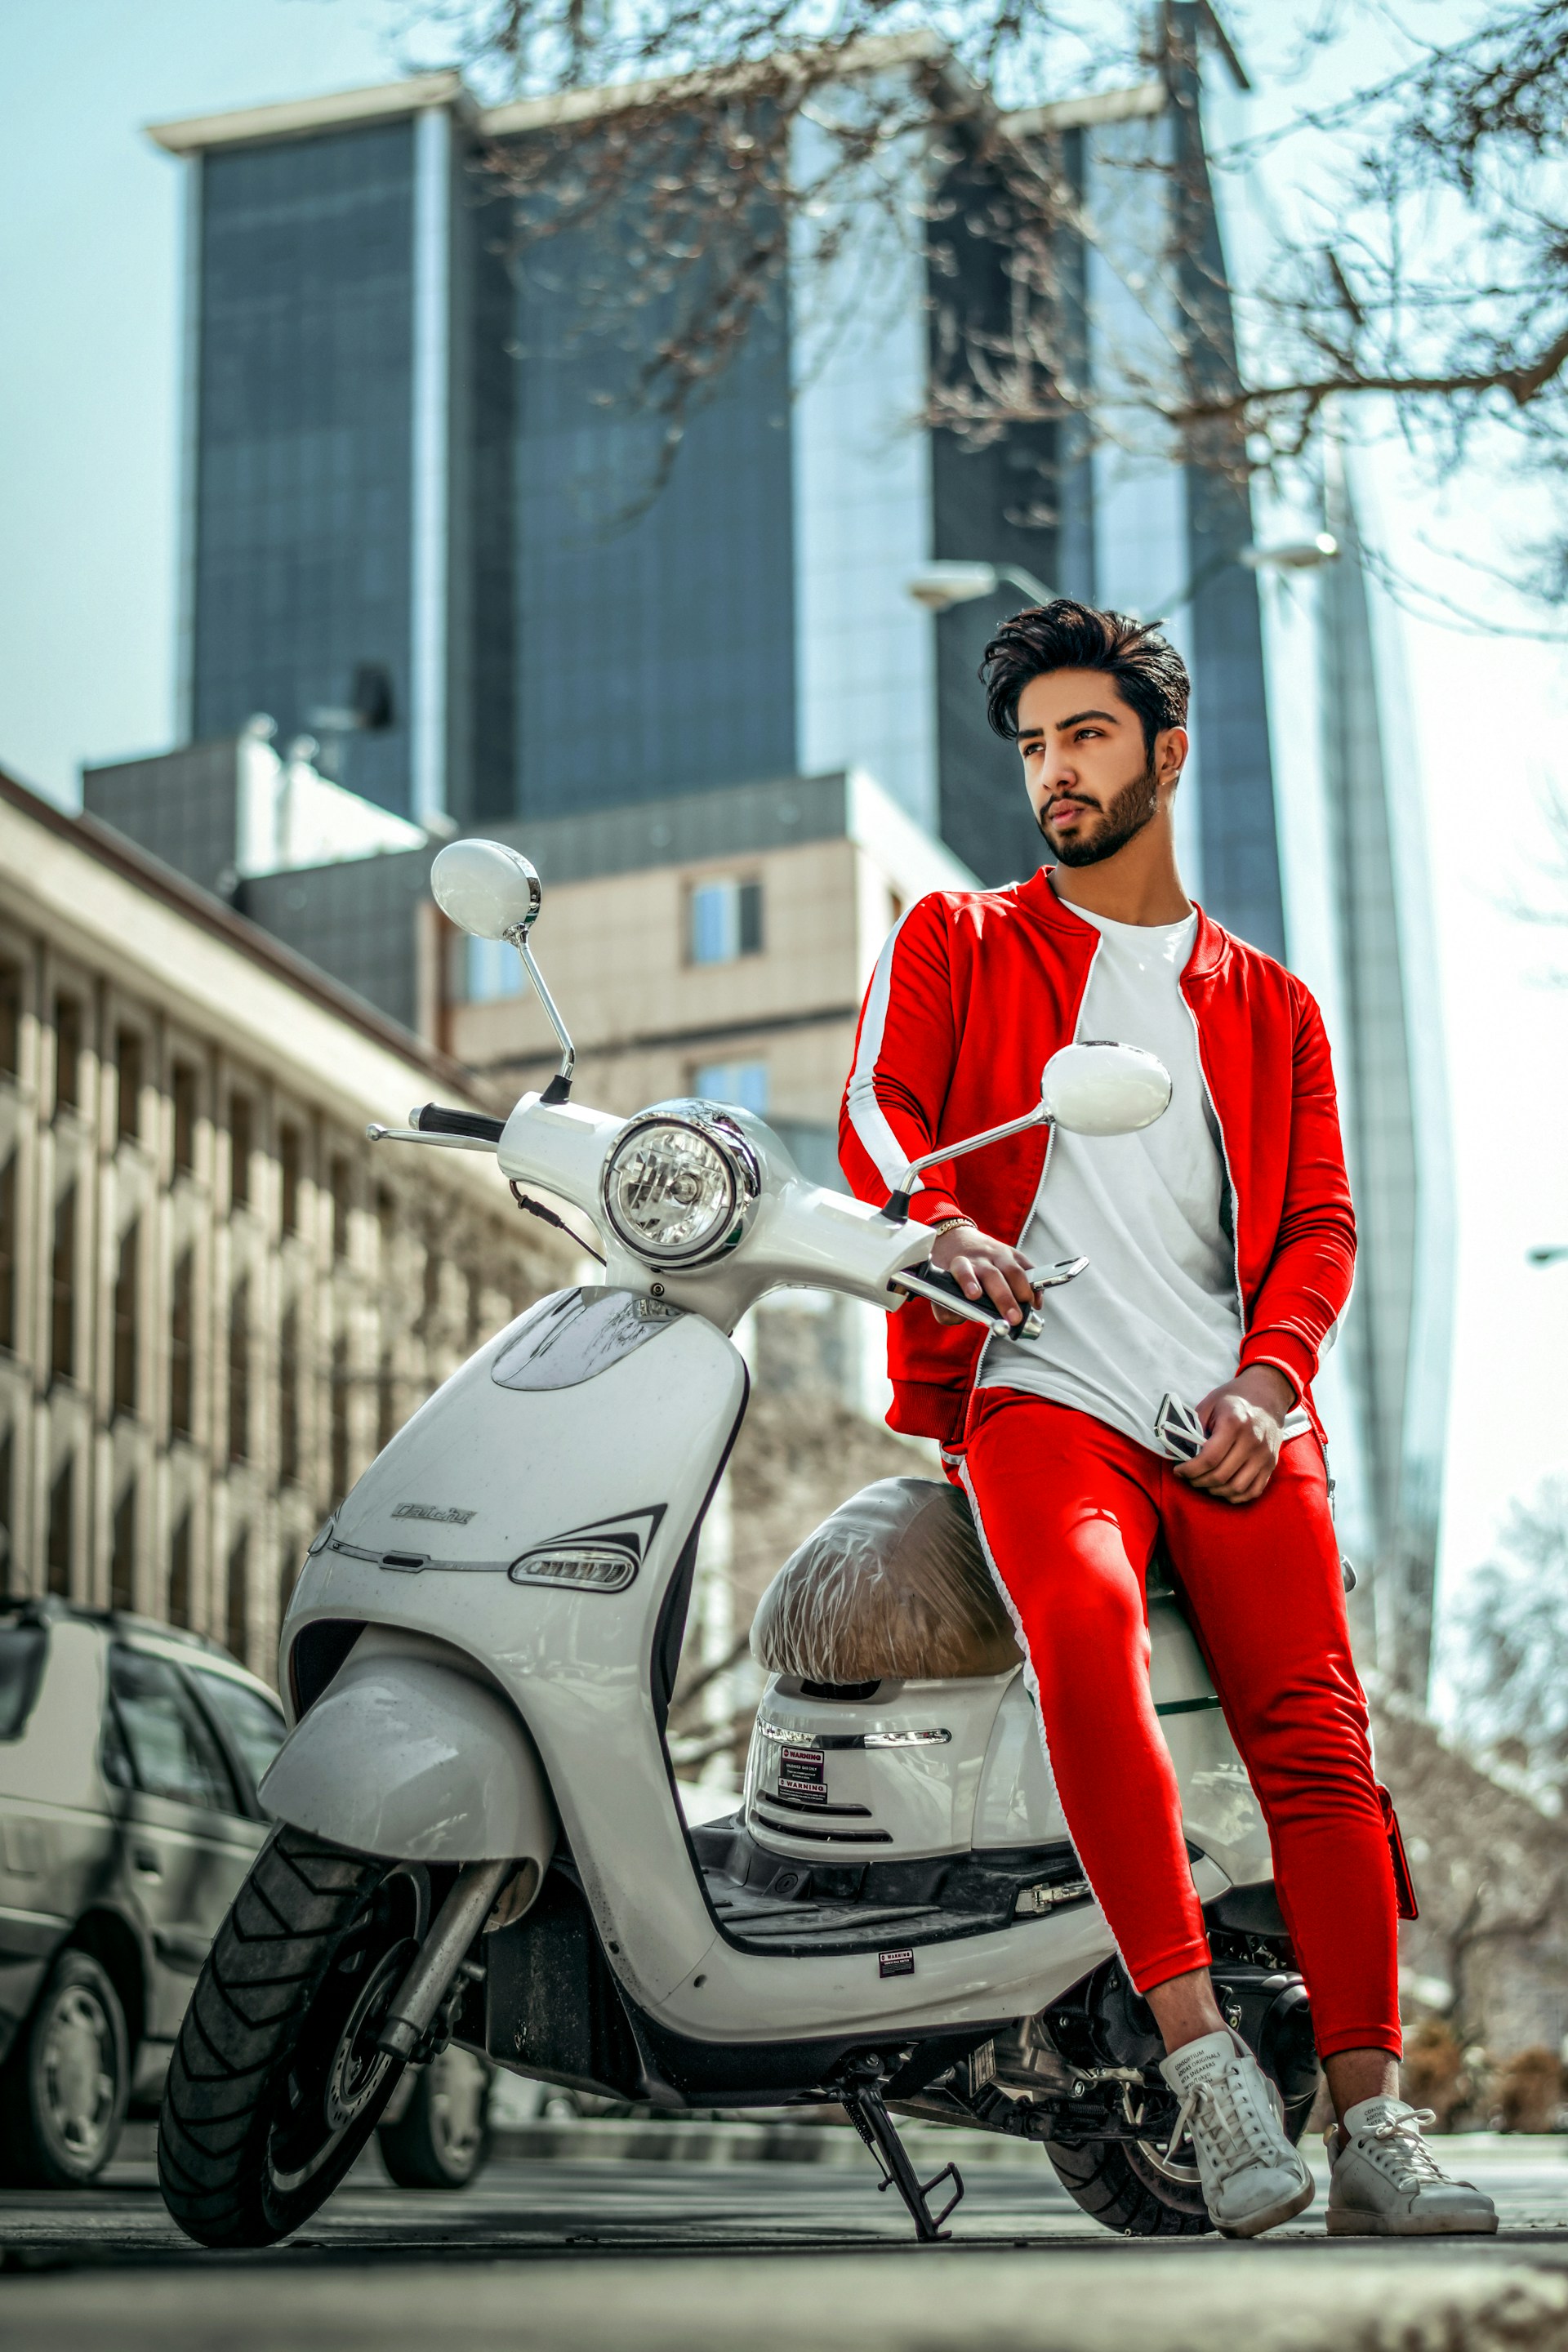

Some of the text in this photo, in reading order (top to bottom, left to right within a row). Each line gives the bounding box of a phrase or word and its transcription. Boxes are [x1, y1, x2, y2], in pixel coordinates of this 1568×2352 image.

[390, 1503, 477, 1525] Daichi
[790, 1751, 822, 1761] WARNING
[786, 1780, 824, 1791] WARNING
[1175, 2050, 1205, 2071] CONSORTIUM
[1192, 2051, 1221, 2067] ORIGINALS
[1190, 2061, 1216, 2078] SNEAKERS
